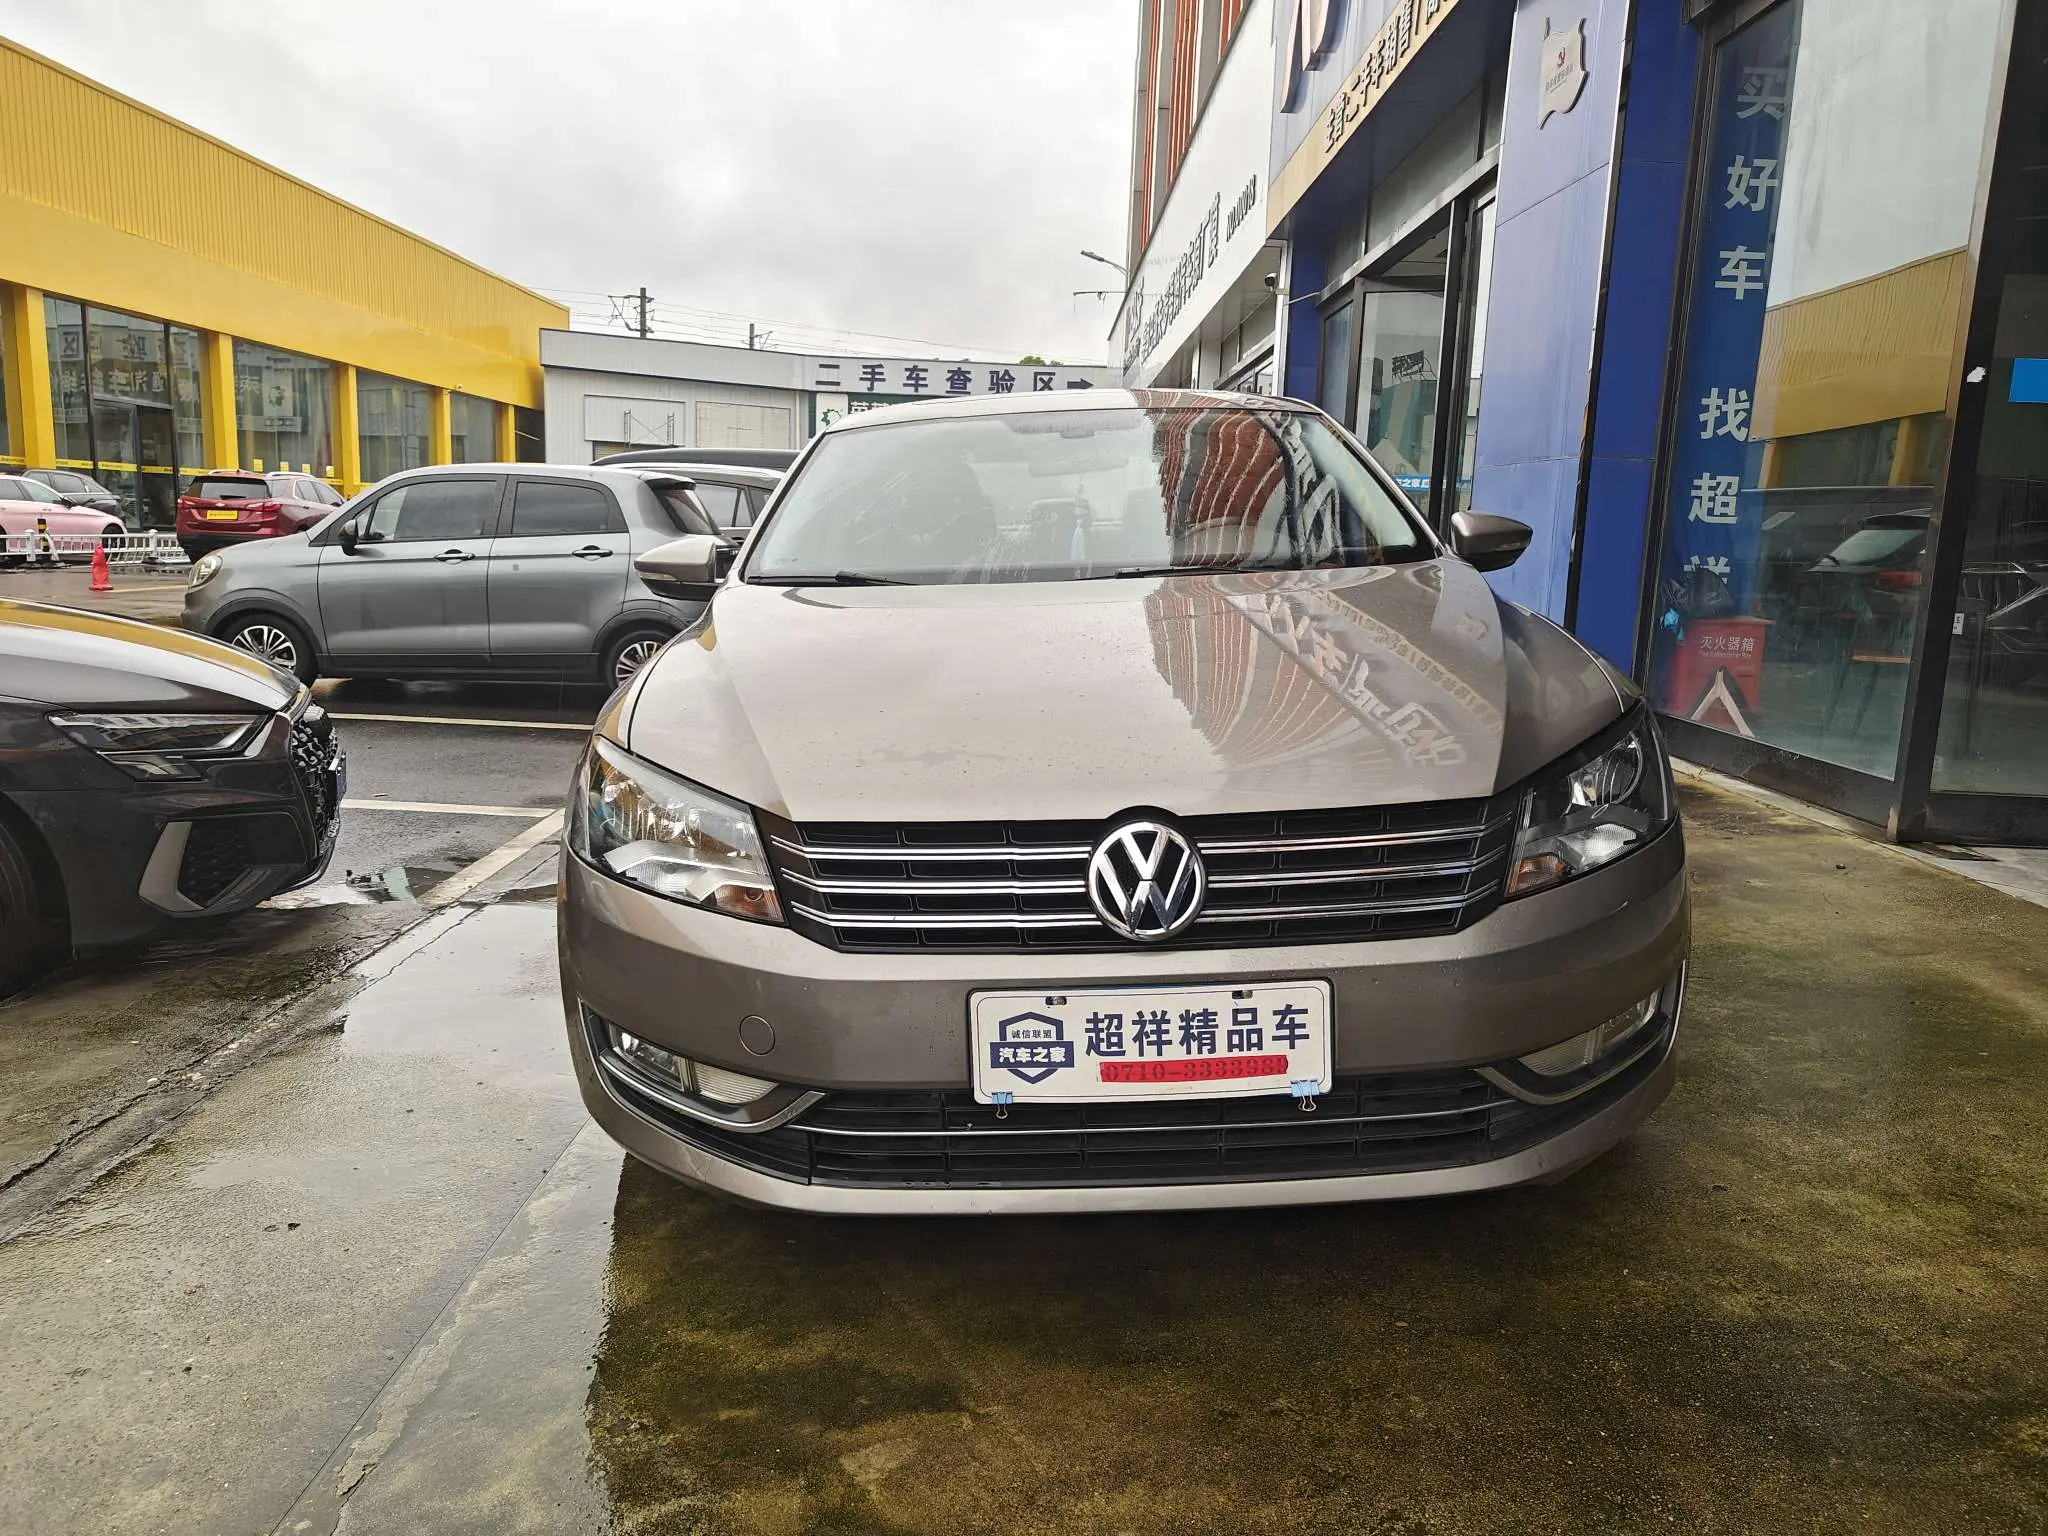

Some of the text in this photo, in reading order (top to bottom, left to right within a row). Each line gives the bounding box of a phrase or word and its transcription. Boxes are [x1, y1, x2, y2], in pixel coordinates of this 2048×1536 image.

[1715, 67, 1787, 300] 买好车
[815, 363, 1056, 395] 二手车查验区
[1700, 636, 1756, 653] 灭火器箱
[1011, 1029, 1053, 1039] 诚信联盟
[1084, 1003, 1310, 1058] 超祥精品车
[998, 1046, 1066, 1063] 汽车之家
